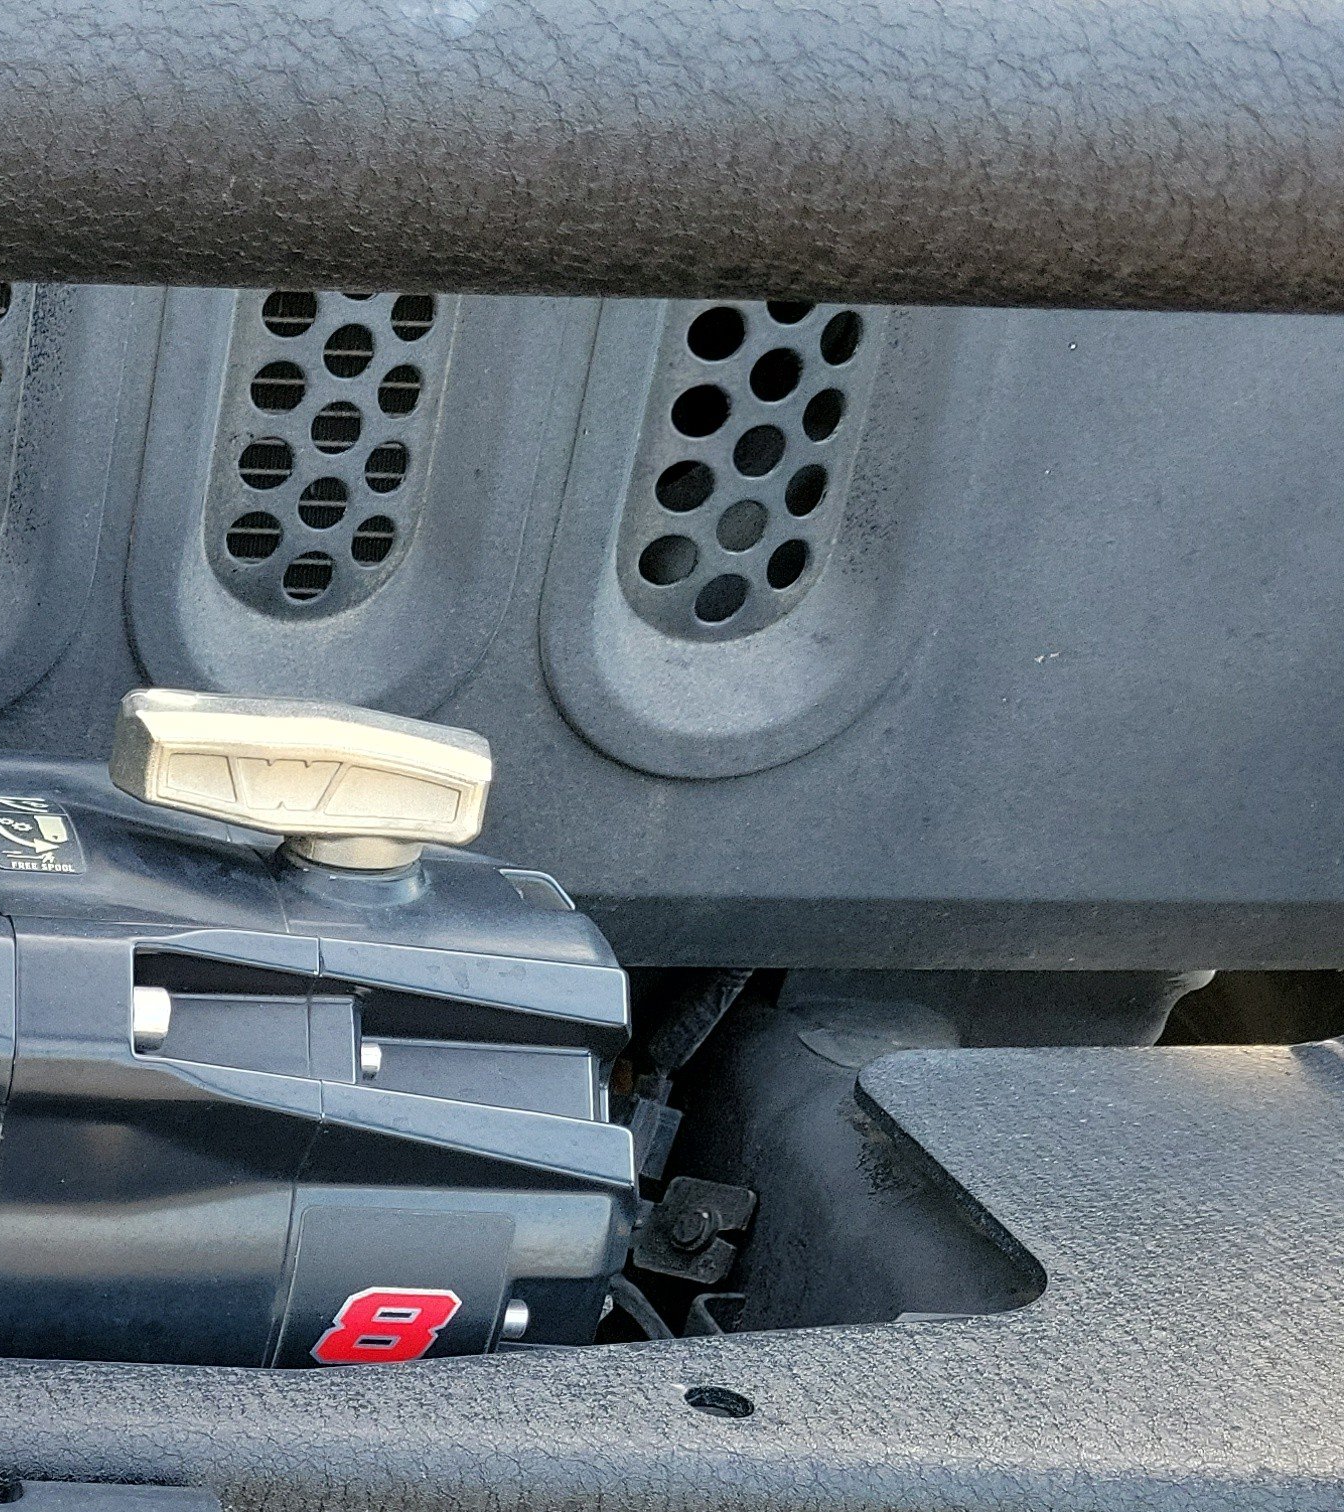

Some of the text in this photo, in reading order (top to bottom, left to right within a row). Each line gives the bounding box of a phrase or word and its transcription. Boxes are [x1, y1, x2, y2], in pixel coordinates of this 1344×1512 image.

[11, 861, 75, 872] FREE SPOOL
[309, 1286, 462, 1364] 8
